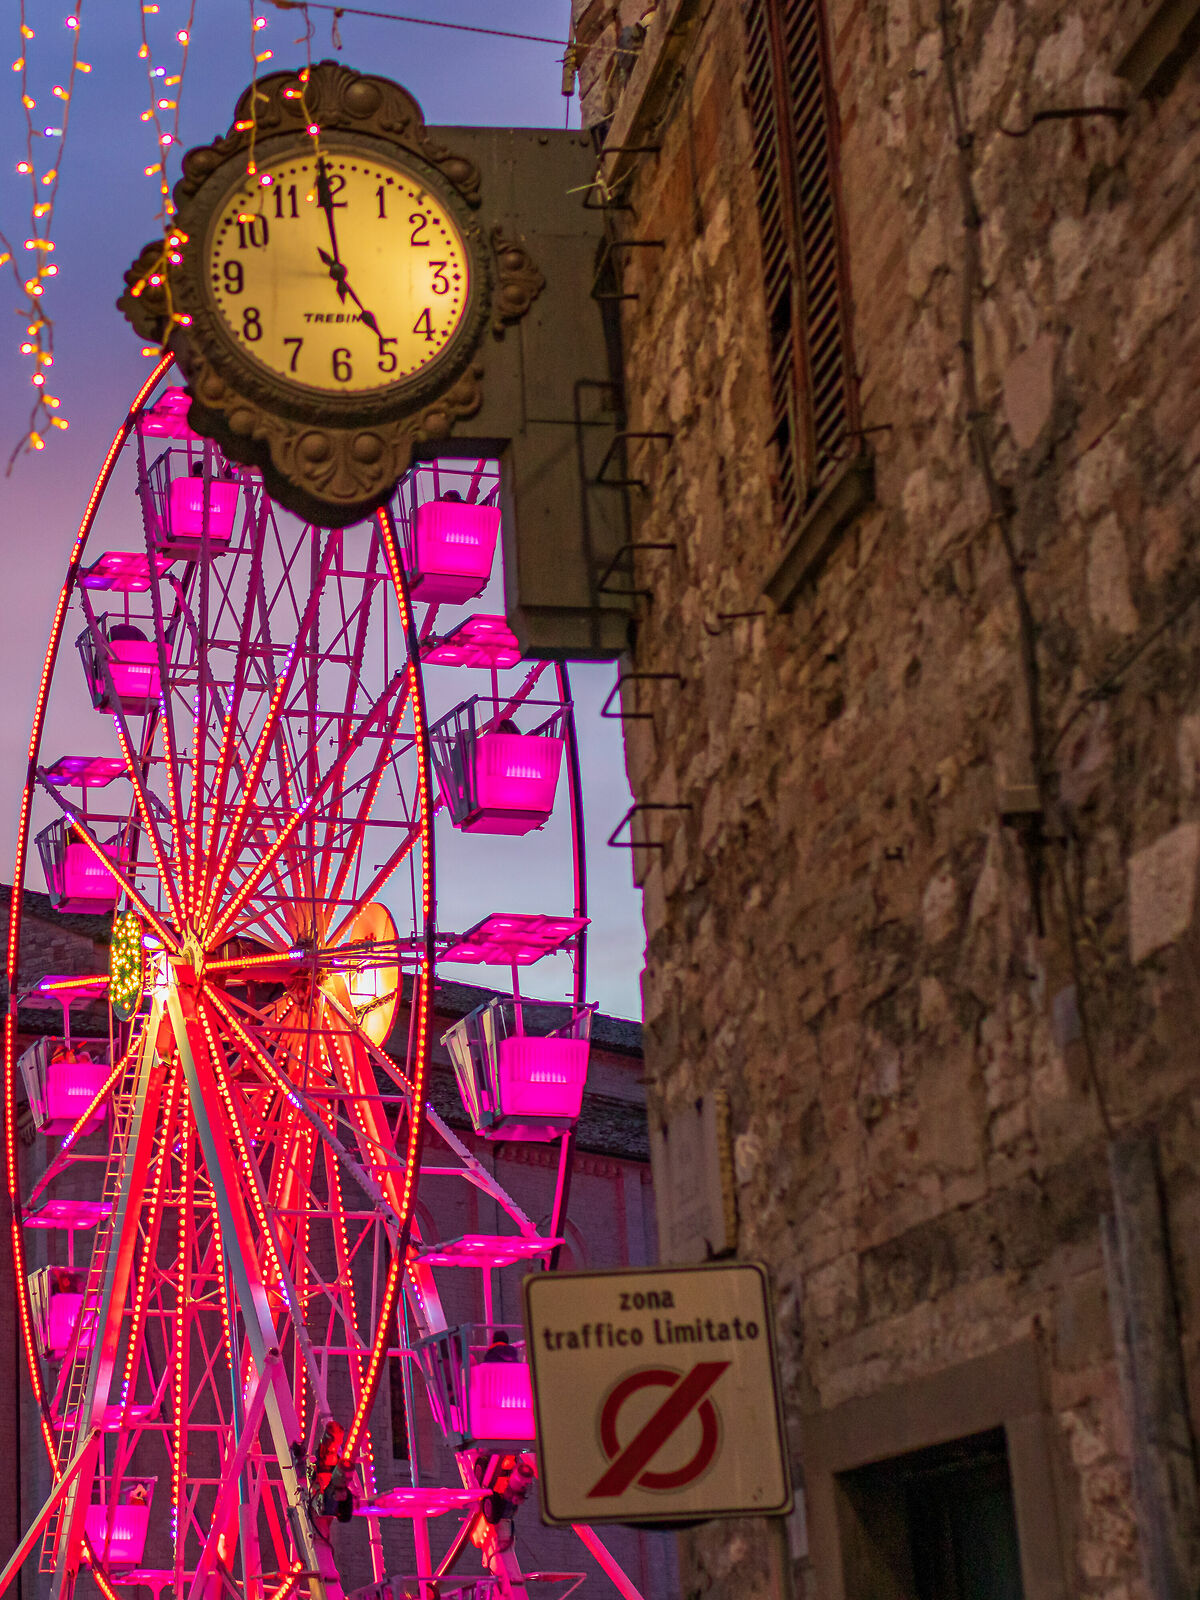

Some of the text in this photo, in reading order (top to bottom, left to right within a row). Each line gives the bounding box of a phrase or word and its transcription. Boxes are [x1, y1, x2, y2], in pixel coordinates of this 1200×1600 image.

[273, 184, 300, 218] 11
[316, 174, 348, 208] 2
[375, 186, 387, 219] 1
[236, 213, 269, 249] 10
[408, 213, 430, 247] 2
[223, 260, 244, 294] 9
[428, 261, 449, 295] 3
[242, 307, 263, 341] 8
[303, 312, 364, 324] TREBIN
[412, 307, 436, 341] 4
[284, 337, 304, 372] 7
[332, 348, 353, 383] 6
[377, 337, 398, 373] 5
[619, 1290, 675, 1311] zona
[543, 1317, 759, 1350] traffico limitato
